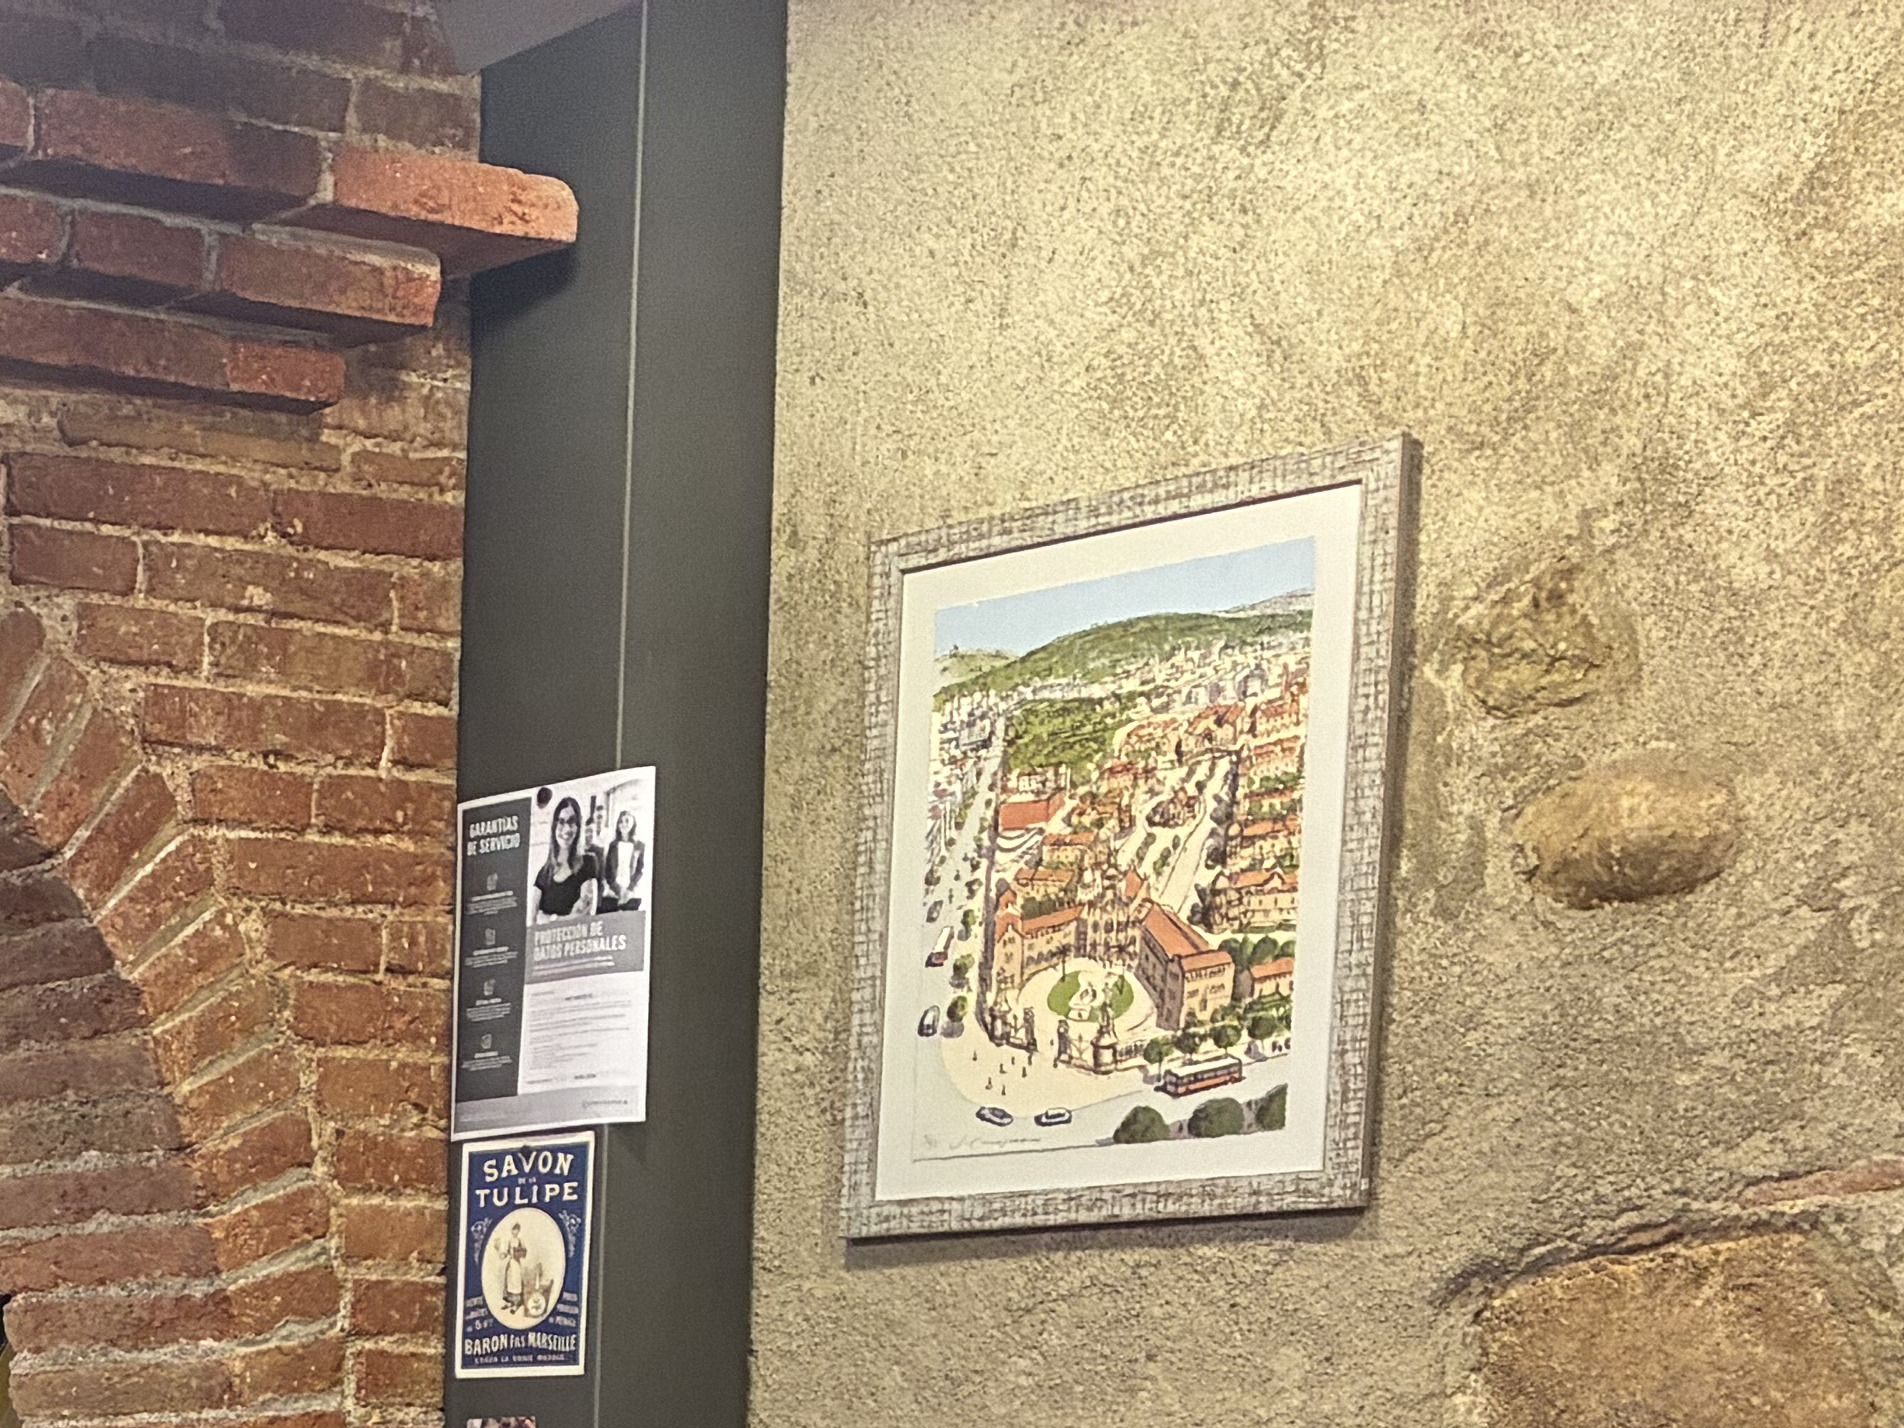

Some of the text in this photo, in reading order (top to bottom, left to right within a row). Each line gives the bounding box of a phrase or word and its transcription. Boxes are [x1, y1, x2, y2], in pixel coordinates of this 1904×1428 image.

[479, 832, 520, 854] SERVICIO
[590, 920, 603, 936] DE
[533, 942, 562, 961] DATOS
[563, 934, 627, 957] PERSONALES
[483, 1150, 574, 1182] SAVON
[475, 1182, 578, 1207] TULIPE
[464, 1334, 508, 1355] BARON
[528, 1331, 576, 1351] MARSEILLE
